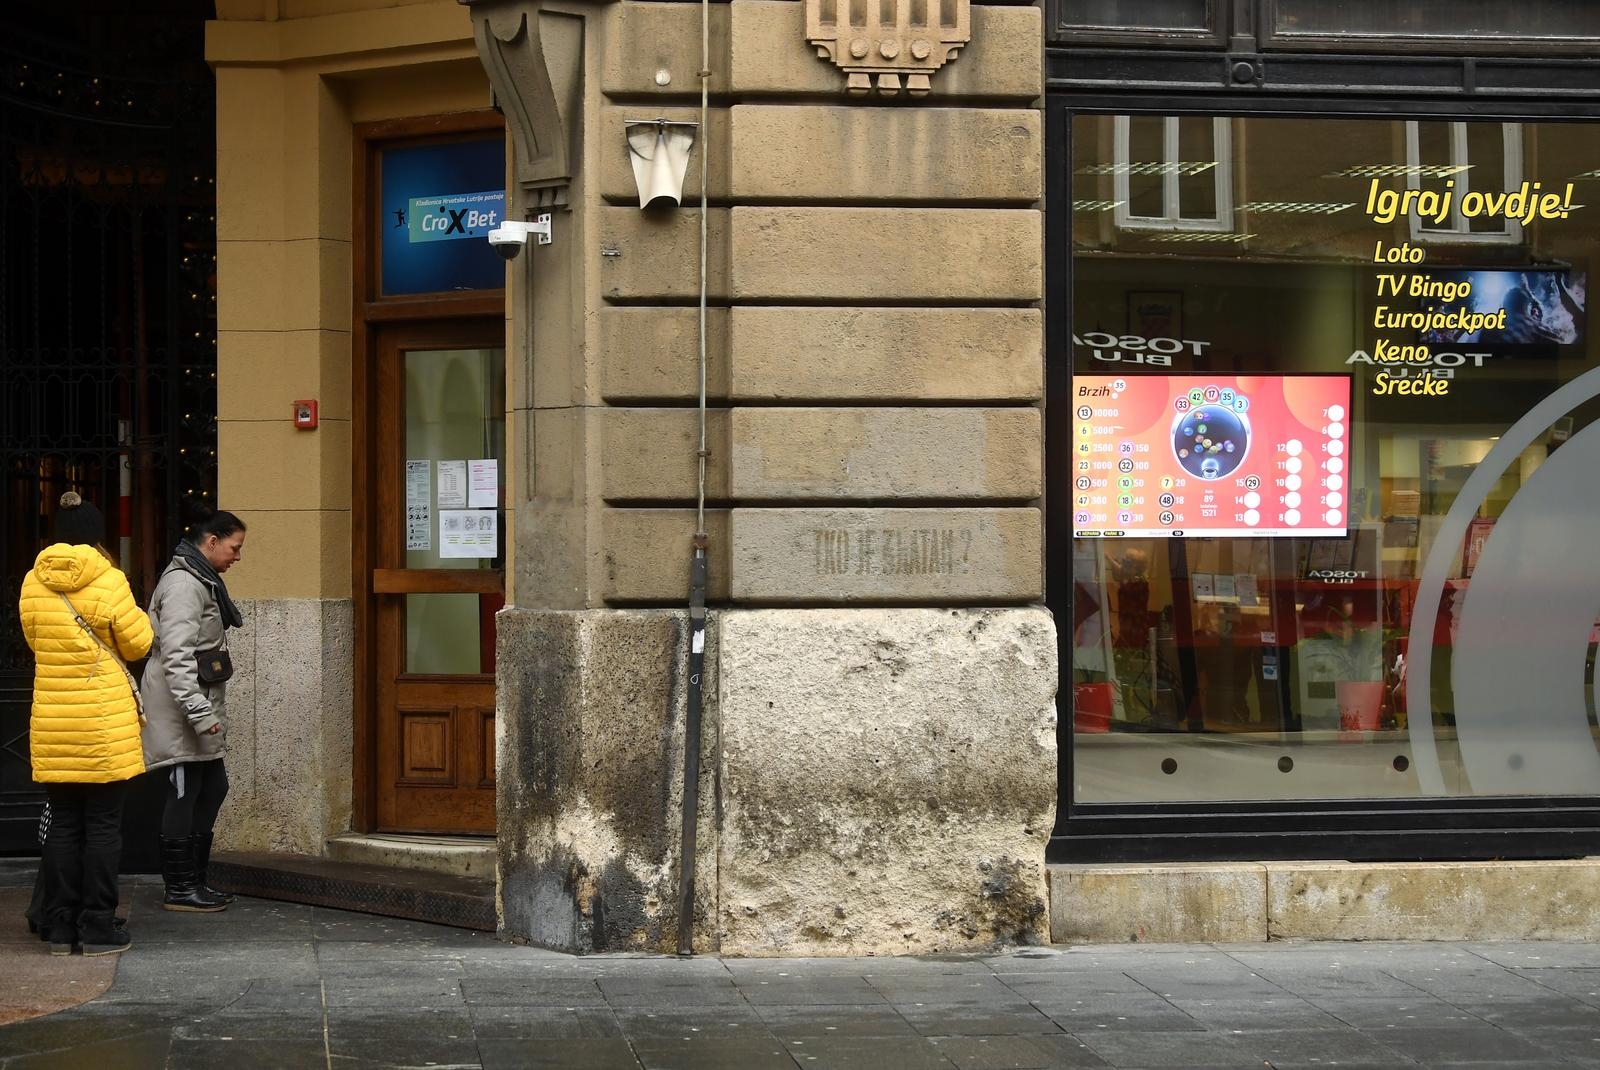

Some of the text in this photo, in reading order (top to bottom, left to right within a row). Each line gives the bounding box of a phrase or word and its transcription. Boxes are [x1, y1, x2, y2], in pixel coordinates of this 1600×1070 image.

[442, 197, 465, 205] Hrvatske
[466, 195, 483, 203] Lutrije
[484, 192, 504, 200] postaje
[1366, 178, 1574, 226] Igraj ovdje!
[1374, 240, 1424, 263] Loto
[1376, 274, 1471, 302] TV Bingo
[1374, 306, 1507, 334] Eurojackpot
[1374, 339, 1429, 362] Keno
[1372, 372, 1449, 396] Srećke
[1078, 386, 1110, 397] Brzih
[1178, 401, 1187, 409] 33
[1192, 393, 1201, 401] 42
[1208, 390, 1215, 398] 17
[1222, 392, 1231, 400] 35
[1081, 408, 1119, 417] 13 10000
[1093, 426, 1114, 435] 5000
[1080, 444, 1089, 452] 46
[1122, 443, 1150, 452] 36 150
[1276, 443, 1286, 452] 12
[1080, 461, 1113, 470] 23 1000
[1121, 461, 1150, 470] 32 100
[1277, 461, 1286, 470] 11
[1080, 479, 1108, 488] 21 500
[1122, 478, 1145, 488] 10 50
[1175, 478, 1186, 487] 20
[1235, 478, 1257, 487] 15 29
[1275, 478, 1285, 487] 10
[1079, 496, 1088, 504] 47
[1122, 496, 1145, 505] 18 40
[1162, 496, 1185, 505] 48 18
[1203, 494, 1214, 503] 89
[1235, 496, 1244, 505] 14
[1201, 508, 1217, 517] 1521
[1078, 514, 1088, 522] 20
[1121, 514, 1129, 522] 12
[1162, 513, 1184, 522] 45 16
